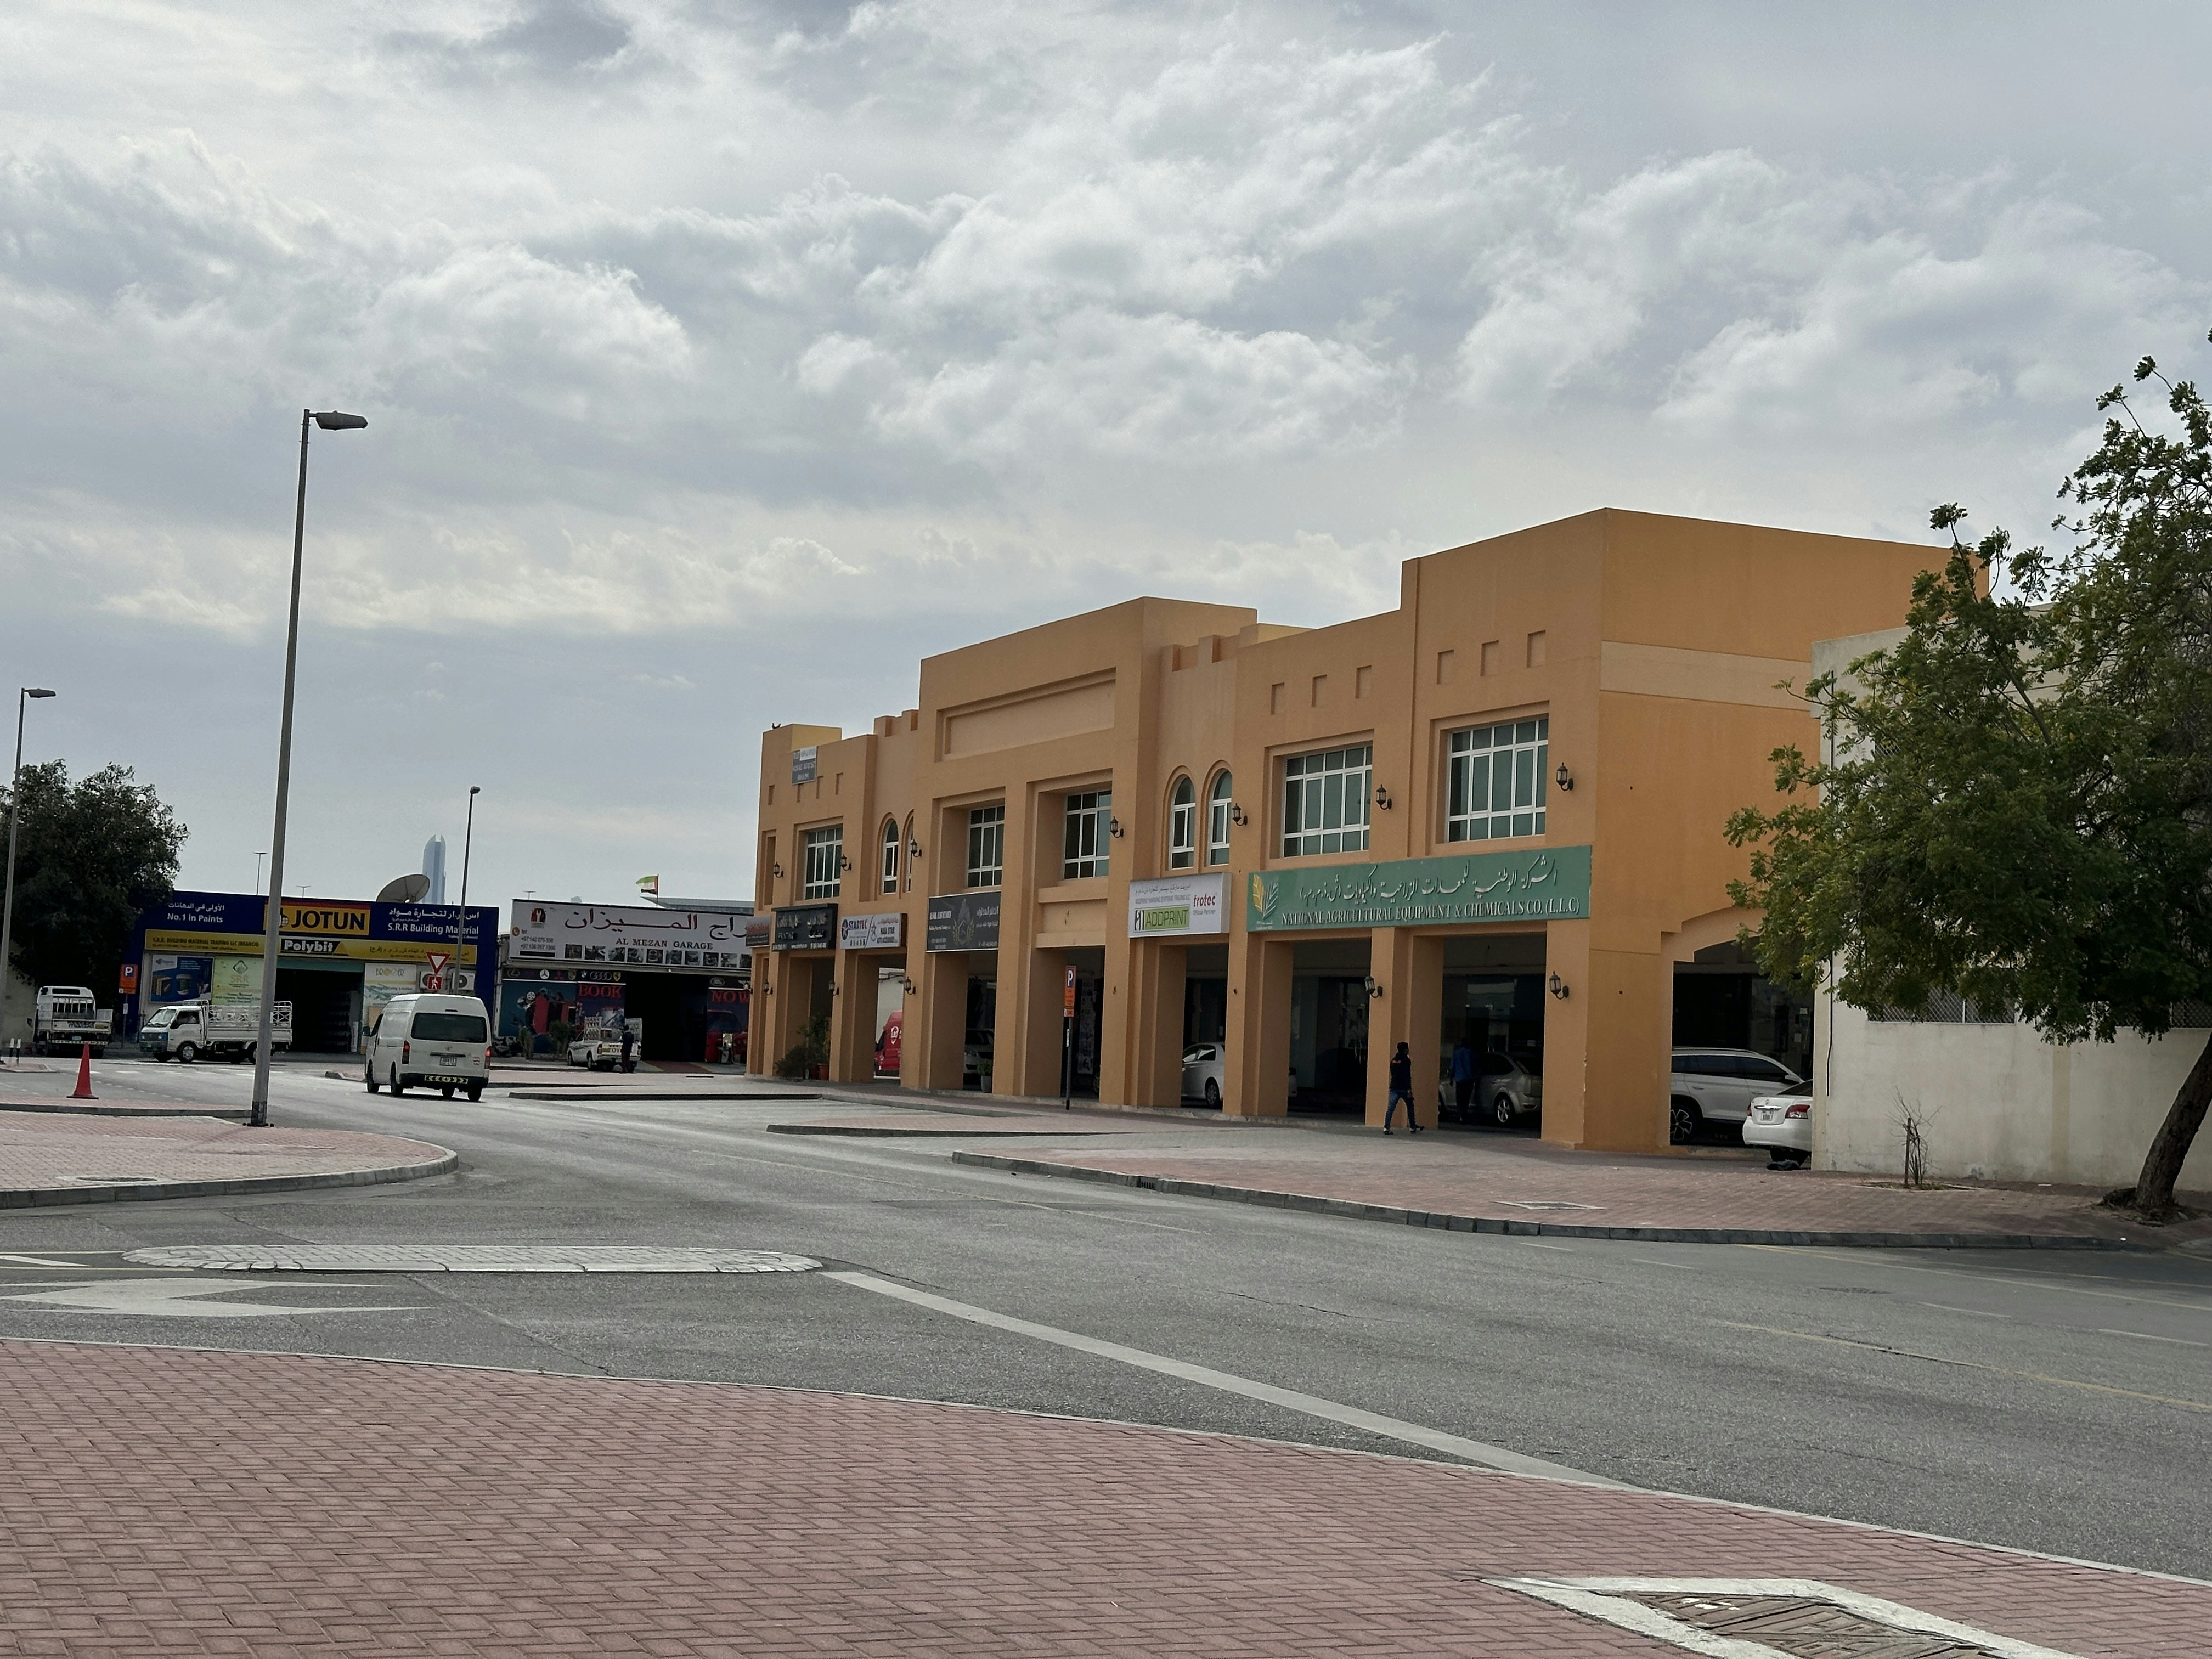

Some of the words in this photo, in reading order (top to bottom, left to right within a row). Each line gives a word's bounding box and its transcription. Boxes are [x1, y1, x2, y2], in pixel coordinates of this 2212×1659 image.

[1422, 859, 1470, 895] للمعدات
[1521, 854, 1557, 889] الشركة
[1472, 868, 1517, 899] الوطنية
[1380, 878, 1418, 903] الزراعية
[1193, 894, 1216, 907] trotec
[195, 903, 205, 912] في
[206, 904, 224, 912] الأولى
[389, 907, 412, 917] مواد
[1282, 909, 1324, 926] NATIONAL
[1326, 905, 1395, 924] AGRICULTURAL
[1396, 904, 1452, 922] EQUIPMENT
[1454, 902, 1462, 918] &
[1464, 900, 1524, 917] CHEMICALS
[1526, 899, 1543, 915] CO.
[1545, 896, 1581, 916] (L.L.C)
[199, 915, 223, 923] Paints
[291, 910, 365, 930] JOTUN
[565, 908, 697, 933] الميزان
[1146, 910, 1189, 927] ADDPRINT
[388, 922, 408, 932] S.R.R
[410, 923, 443, 935] Building
[445, 925, 479, 934] Maerial
[284, 940, 334, 953] Polybit
[633, 939, 668, 947] MEZAN
[673, 941, 713, 950] GARAGE
[125, 967, 133, 976] P
[1068, 970, 1073, 986] P
[579, 984, 622, 998] BOOK
[711, 990, 750, 1003] NOW
